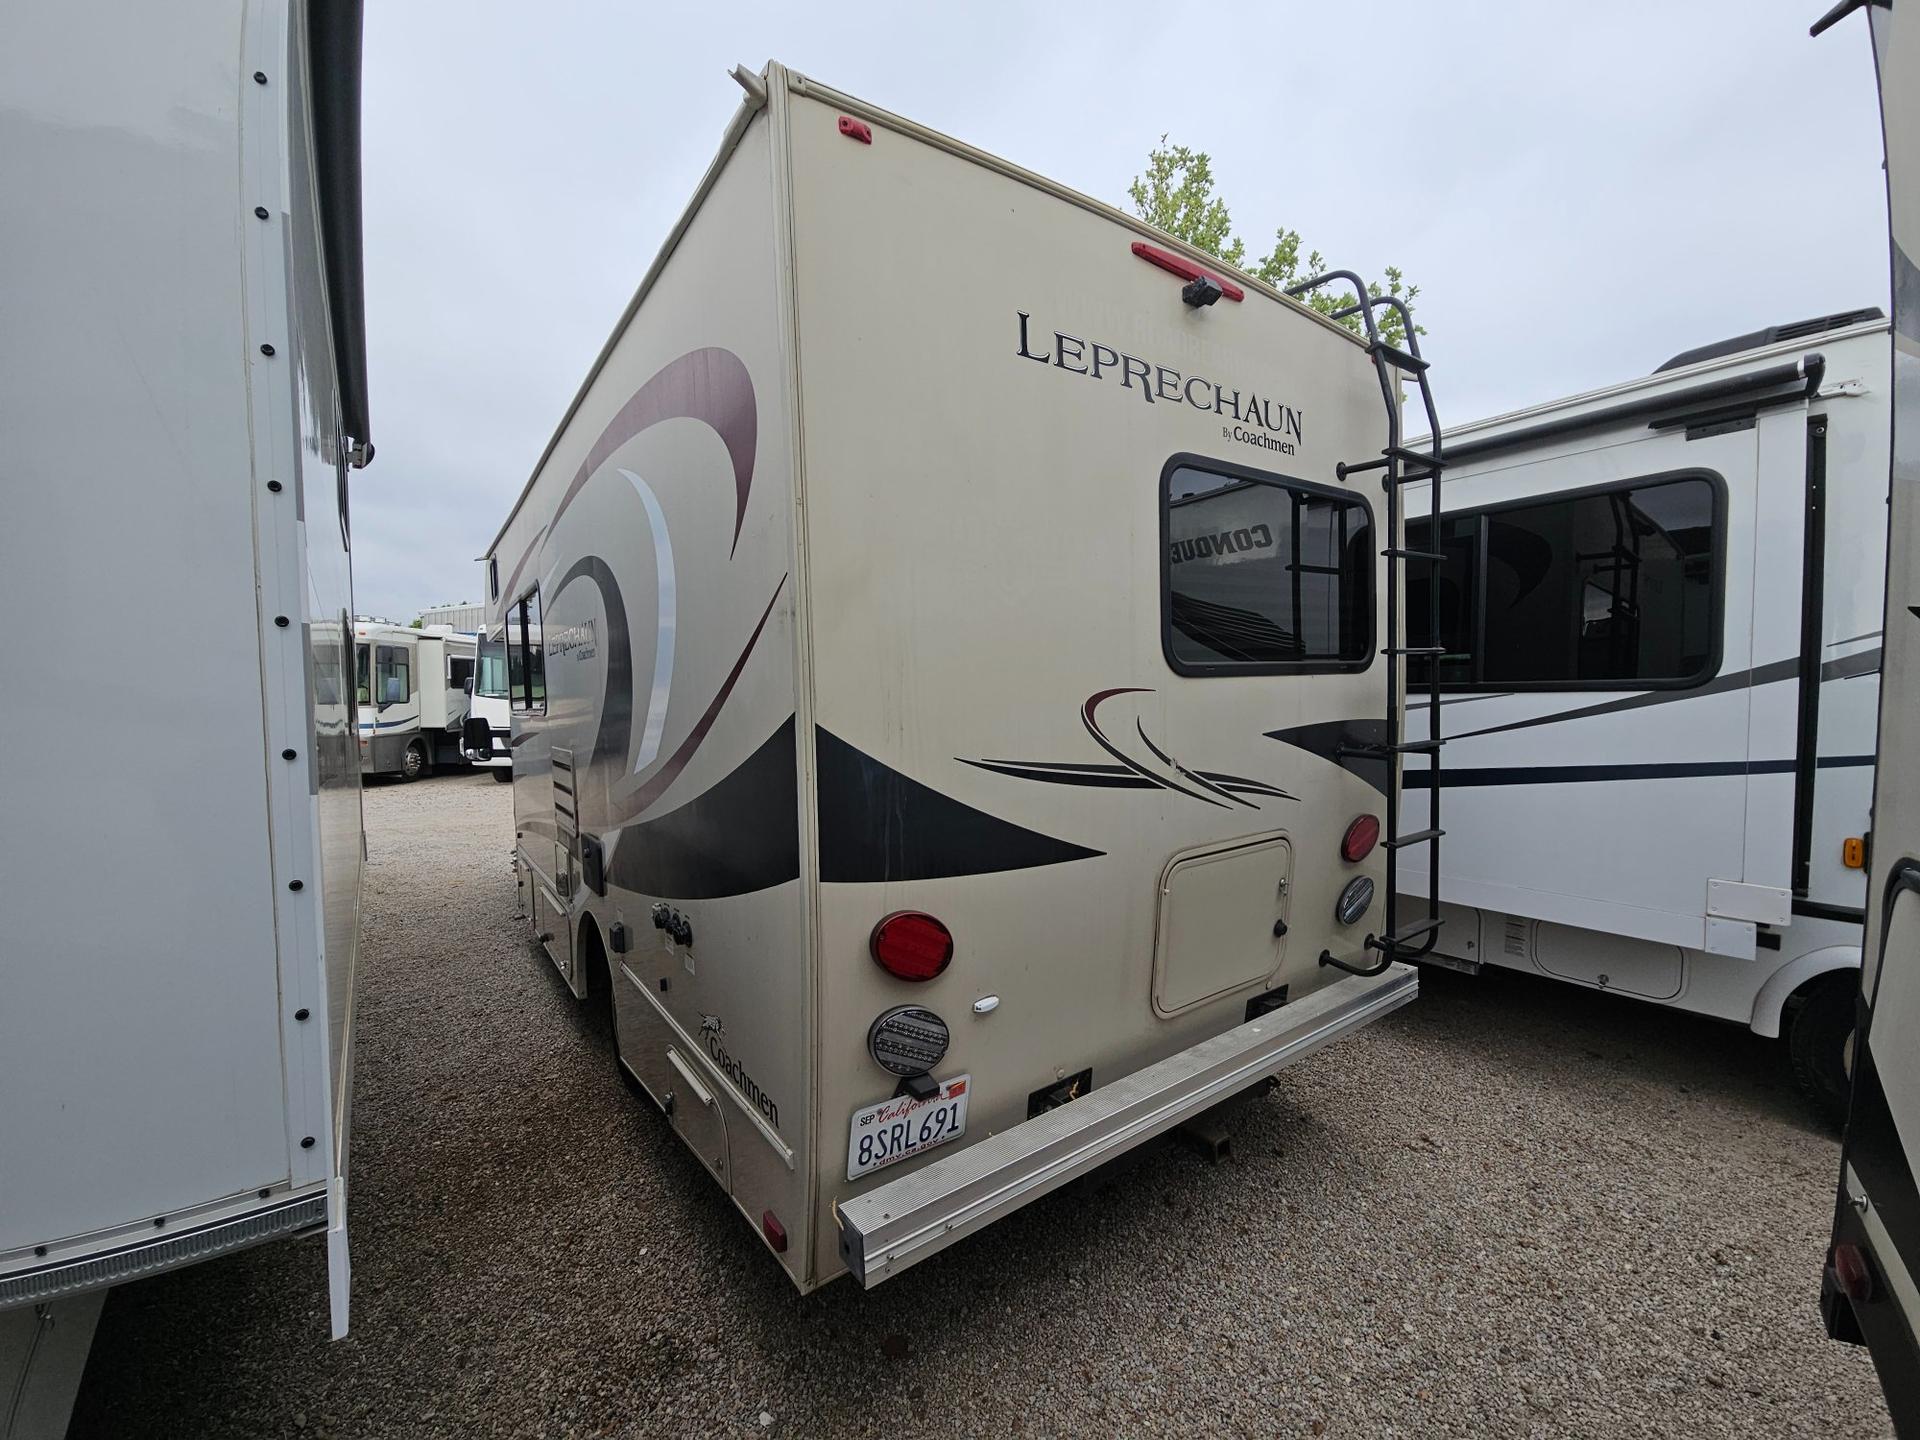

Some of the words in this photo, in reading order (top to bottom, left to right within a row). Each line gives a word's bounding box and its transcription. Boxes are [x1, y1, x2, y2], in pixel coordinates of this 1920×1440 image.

[1016, 310, 1303, 446] LEPRECHAUN
[1222, 427, 1233, 442] By
[1233, 426, 1295, 456] Coachmen
[710, 1036, 780, 1129] Coachmen
[858, 1102, 959, 1167] 8SRL691
[860, 1114, 875, 1127] SEP
